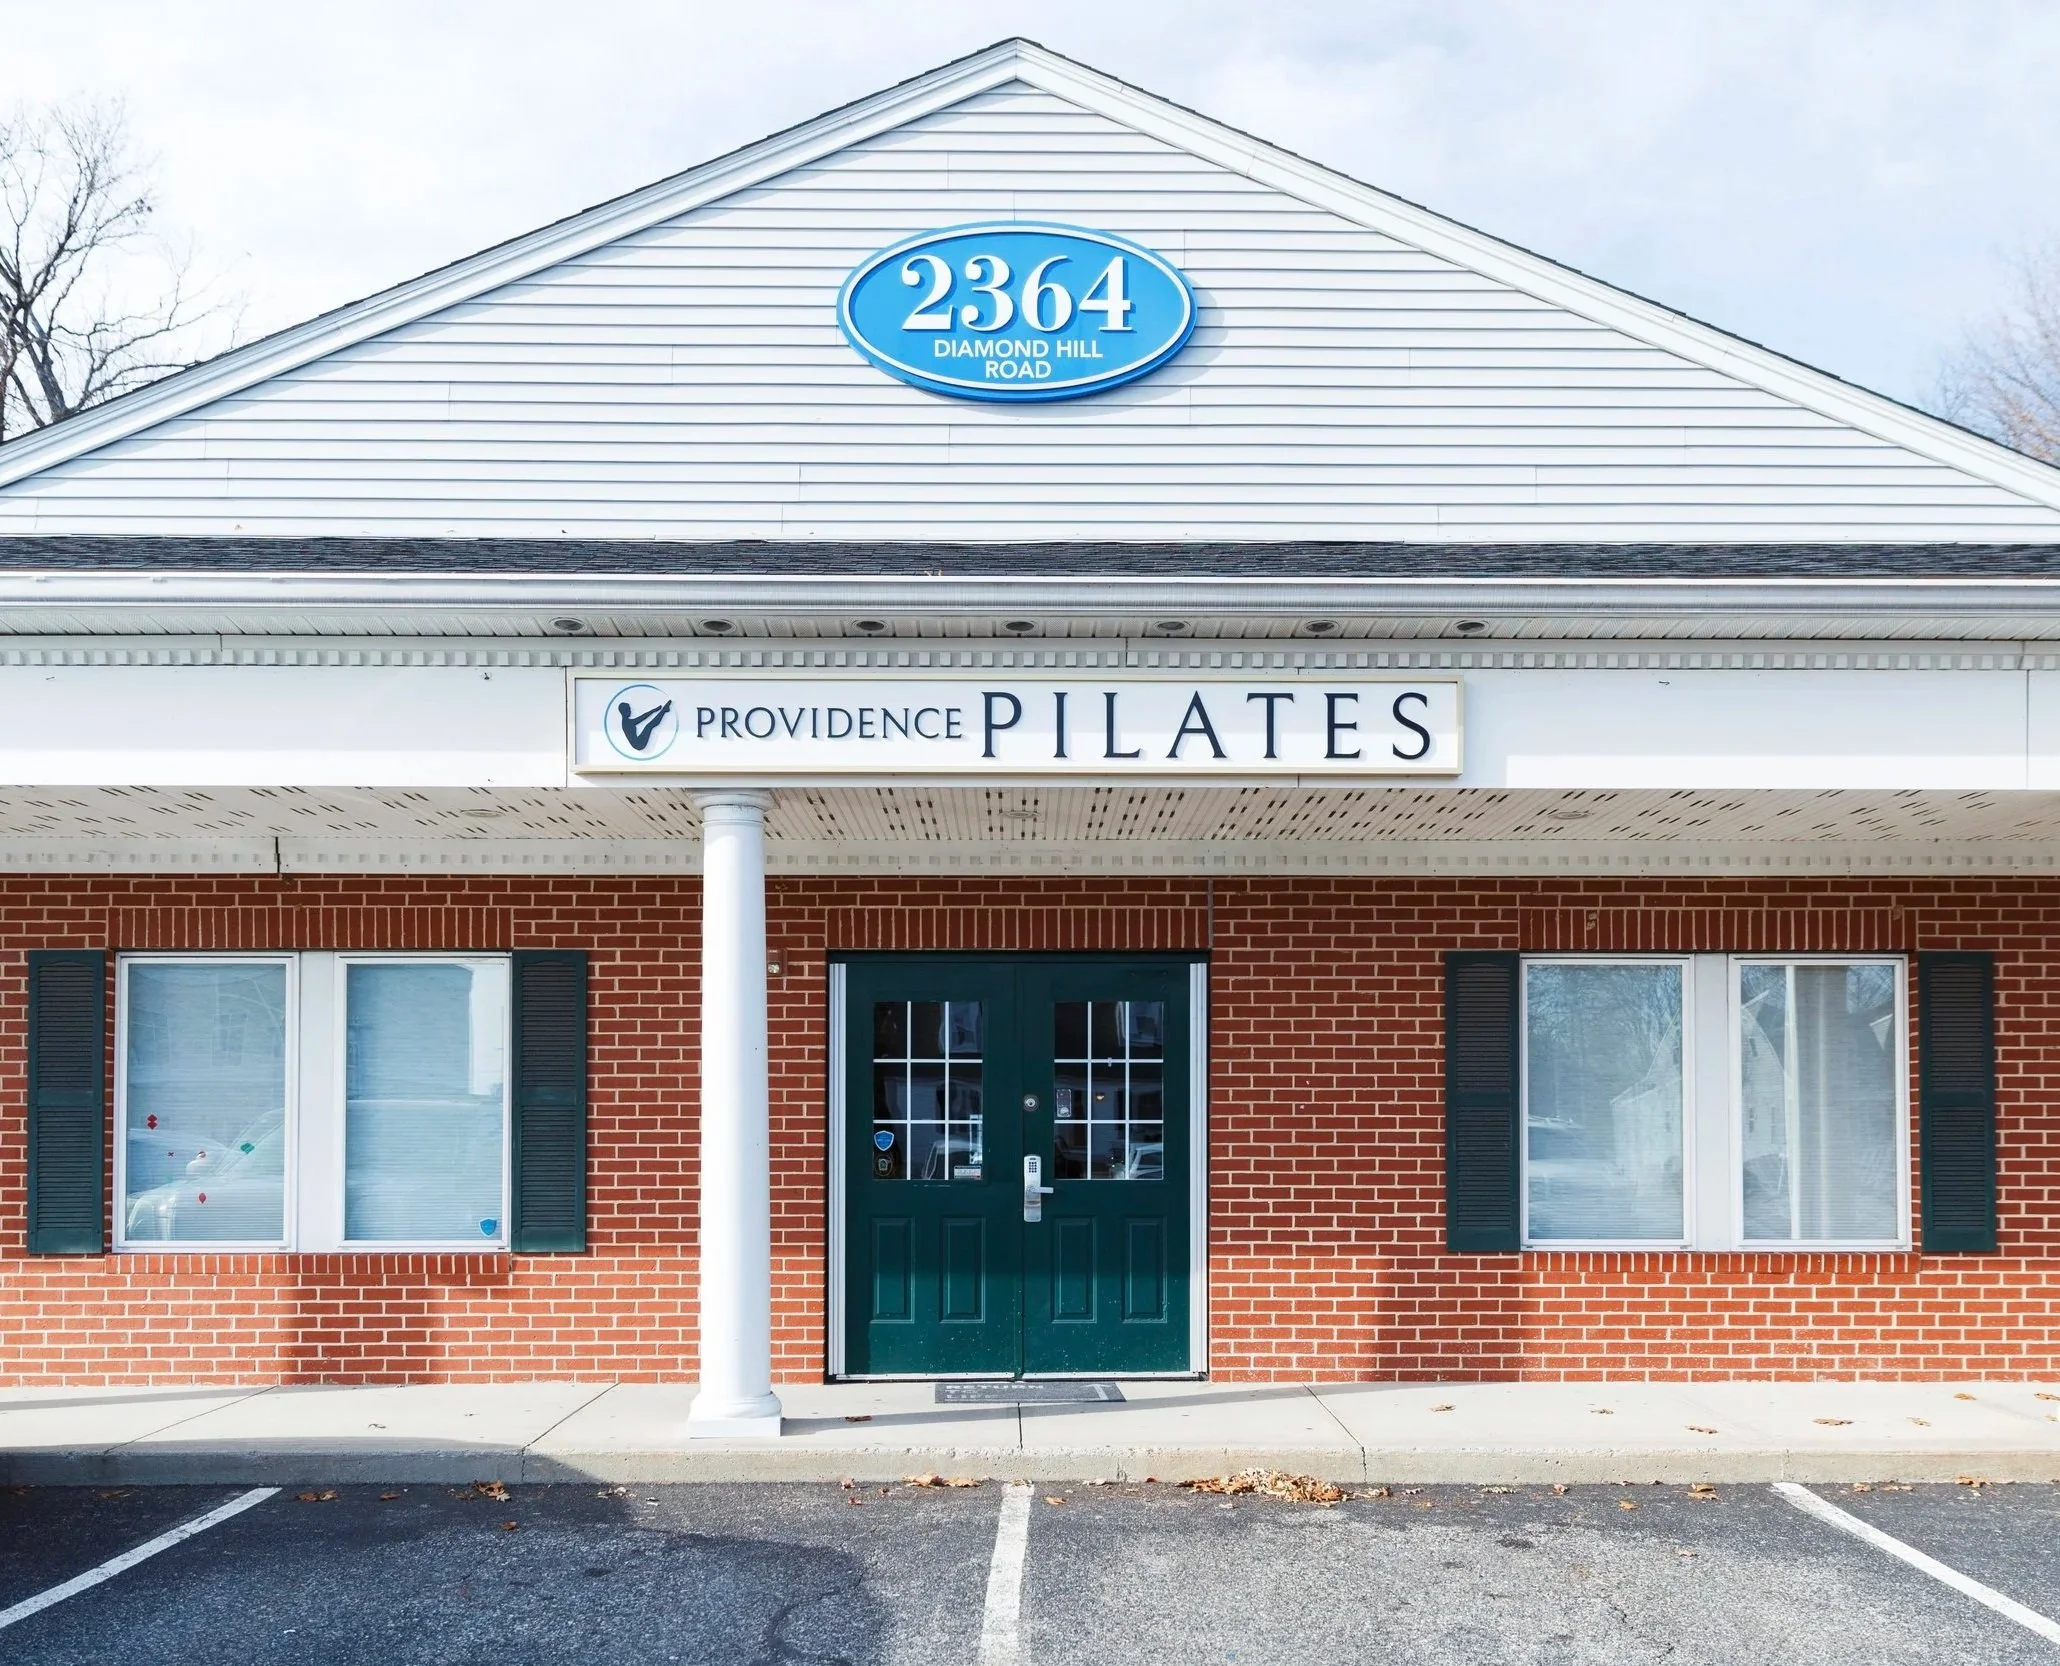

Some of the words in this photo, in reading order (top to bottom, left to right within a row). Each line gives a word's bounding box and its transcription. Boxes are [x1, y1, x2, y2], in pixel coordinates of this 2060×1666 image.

[901, 254, 1134, 332] 2364
[934, 339, 1050, 359] DIAMOND
[1056, 340, 1104, 358] HILL
[984, 360, 1052, 379] ROAD
[696, 706, 963, 739] PROVIDENCE
[980, 689, 1432, 760] PILATES
